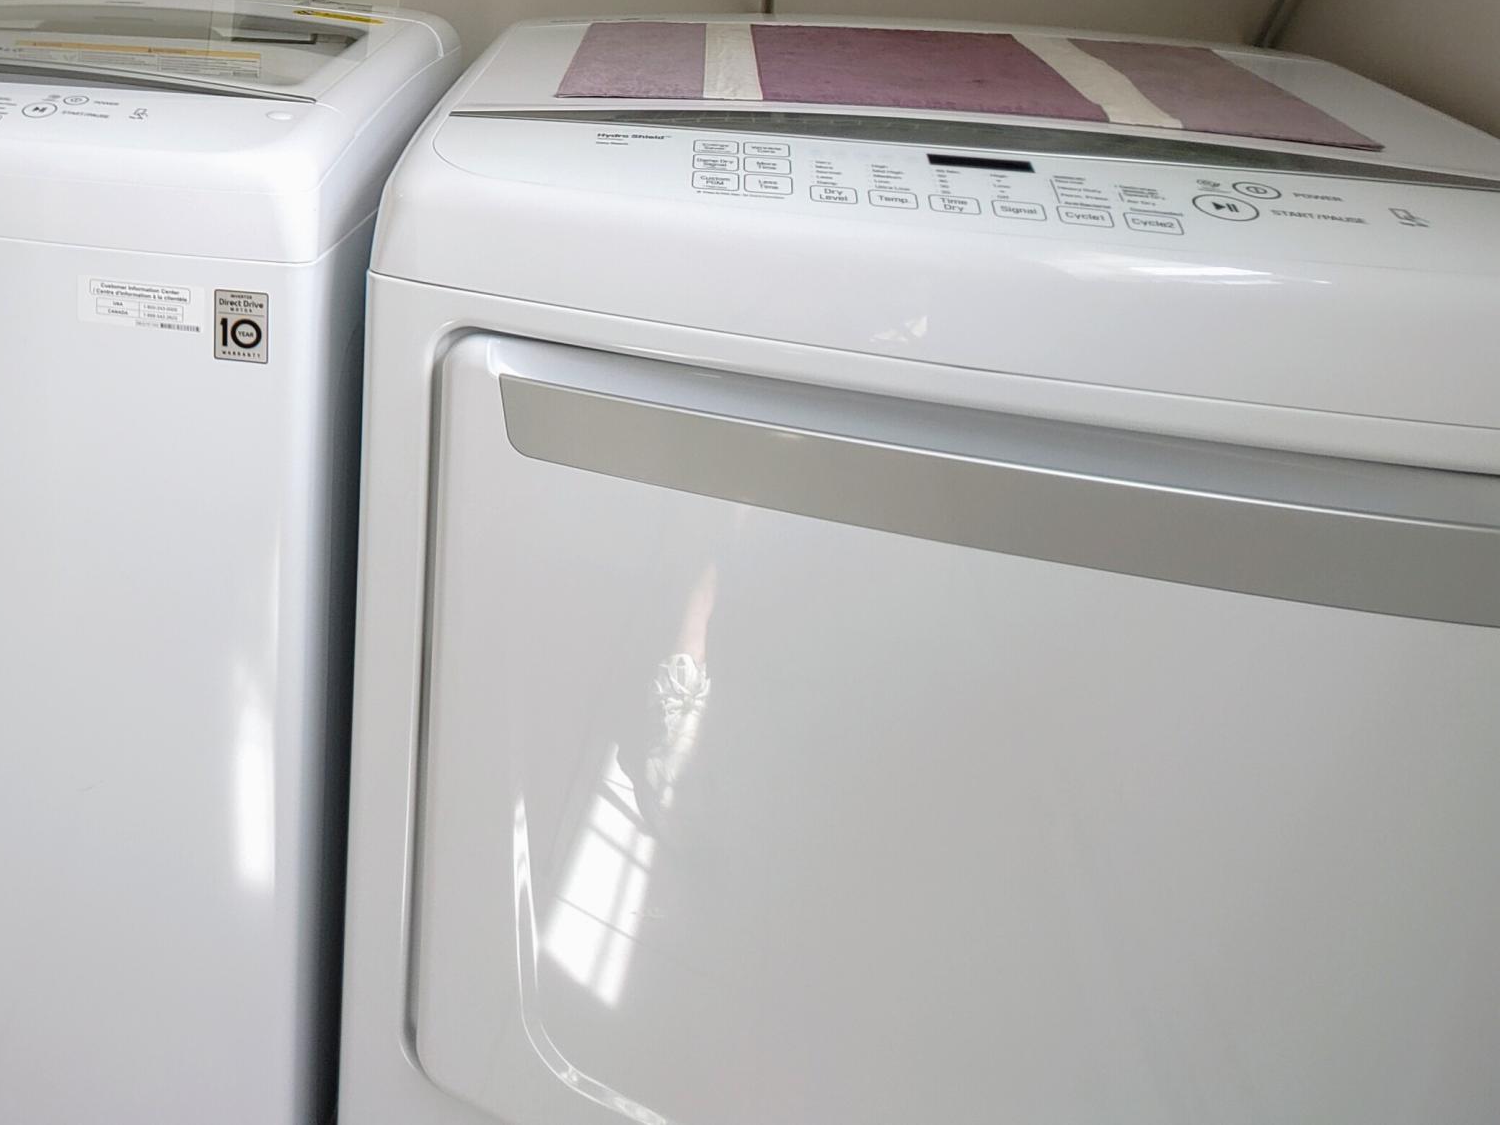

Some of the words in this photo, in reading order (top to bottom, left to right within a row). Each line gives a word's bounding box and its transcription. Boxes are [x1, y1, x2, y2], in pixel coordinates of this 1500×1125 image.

[823, 188, 844, 197] Dry
[819, 194, 849, 202] Level
[940, 197, 969, 206] Time
[943, 204, 965, 213] Dry
[1000, 205, 1038, 215] Signal
[1131, 217, 1177, 229] Cycle2
[218, 298, 242, 308] Direct
[243, 300, 264, 310] Drive
[220, 317, 263, 350] 10
[237, 330, 255, 338] YEAR
